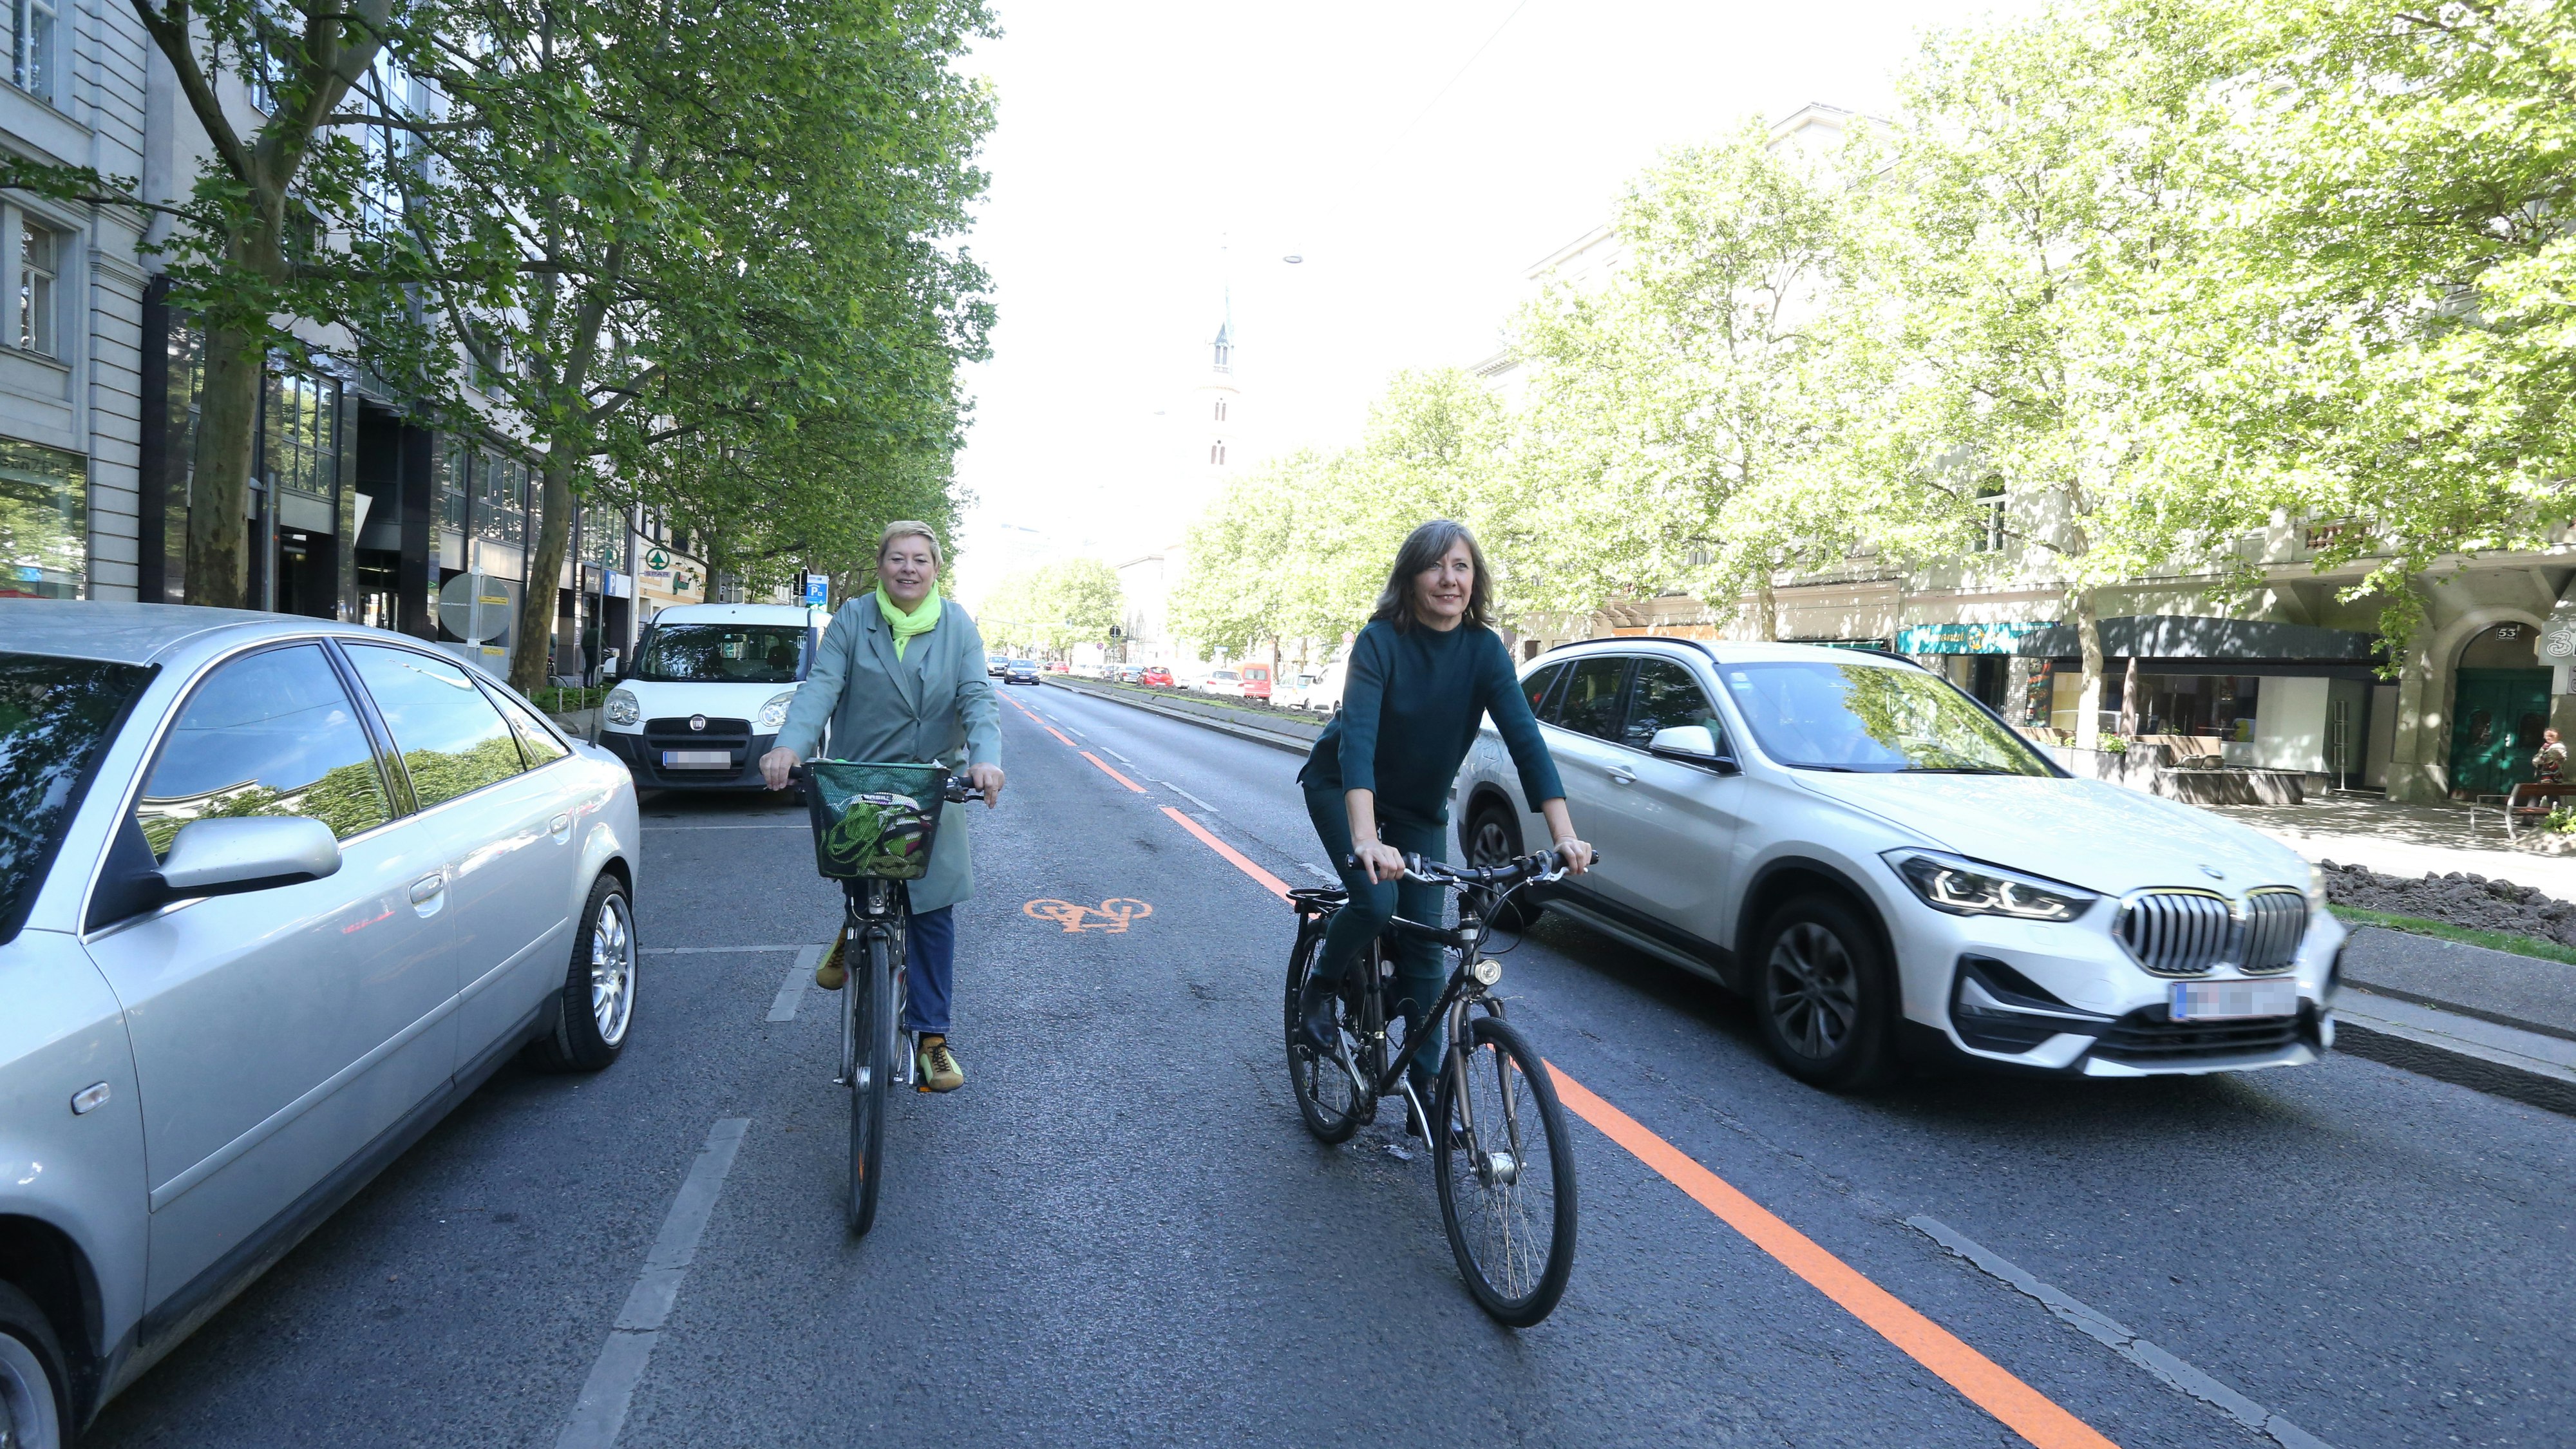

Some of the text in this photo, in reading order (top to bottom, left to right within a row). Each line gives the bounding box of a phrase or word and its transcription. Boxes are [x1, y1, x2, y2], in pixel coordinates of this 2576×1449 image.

[610, 574, 616, 593] P
[2498, 629, 2516, 637] 53
[2547, 630, 2573, 657] 3
